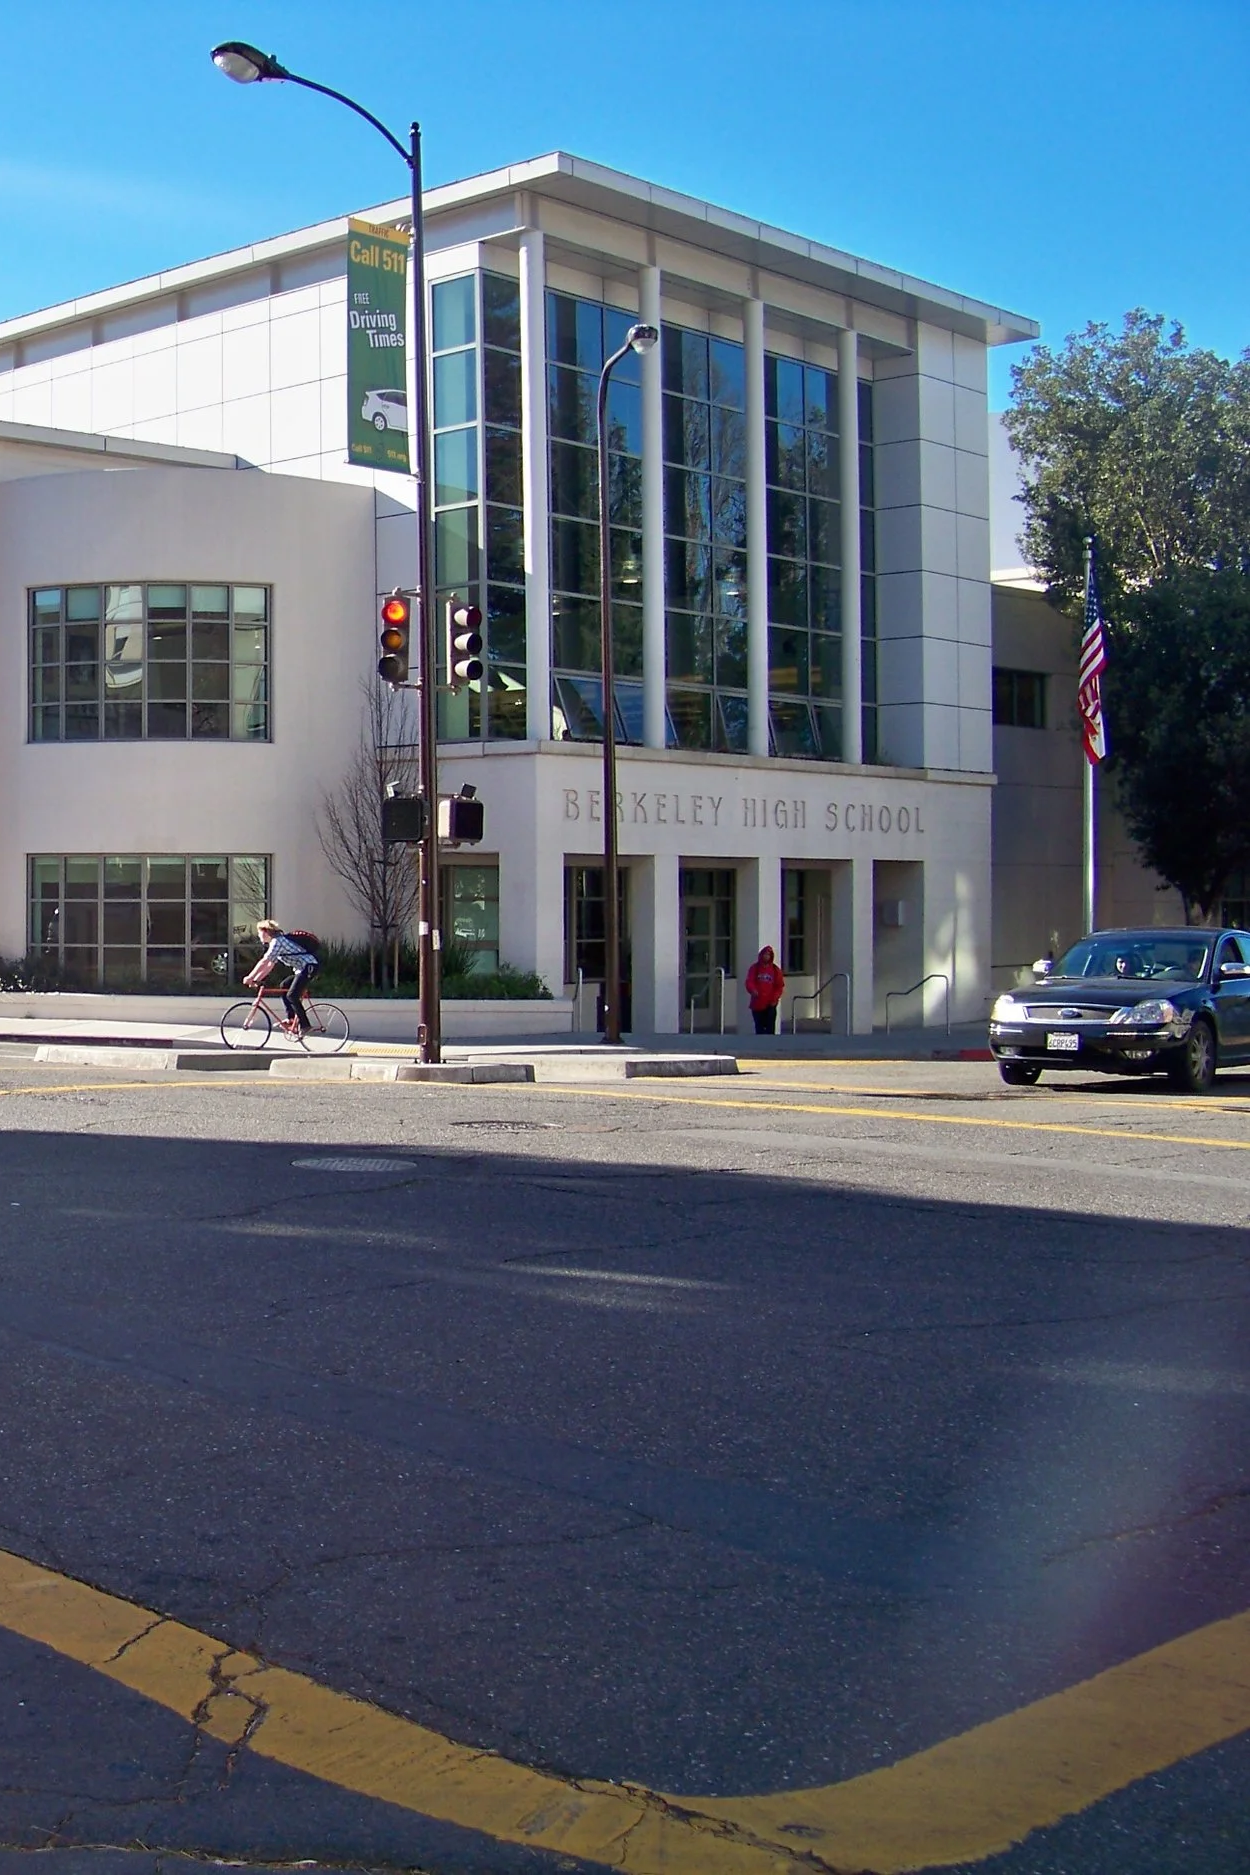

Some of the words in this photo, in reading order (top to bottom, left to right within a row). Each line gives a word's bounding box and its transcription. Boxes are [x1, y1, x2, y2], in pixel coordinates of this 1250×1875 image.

[350, 240, 379, 268] Call
[382, 249, 405, 275] 511
[353, 292, 370, 305] FREE
[349, 309, 397, 331] Driving
[365, 329, 405, 348] Times
[562, 788, 723, 826] BERKELEY
[742, 798, 806, 829] HIGH
[825, 802, 925, 834] SCHOOL
